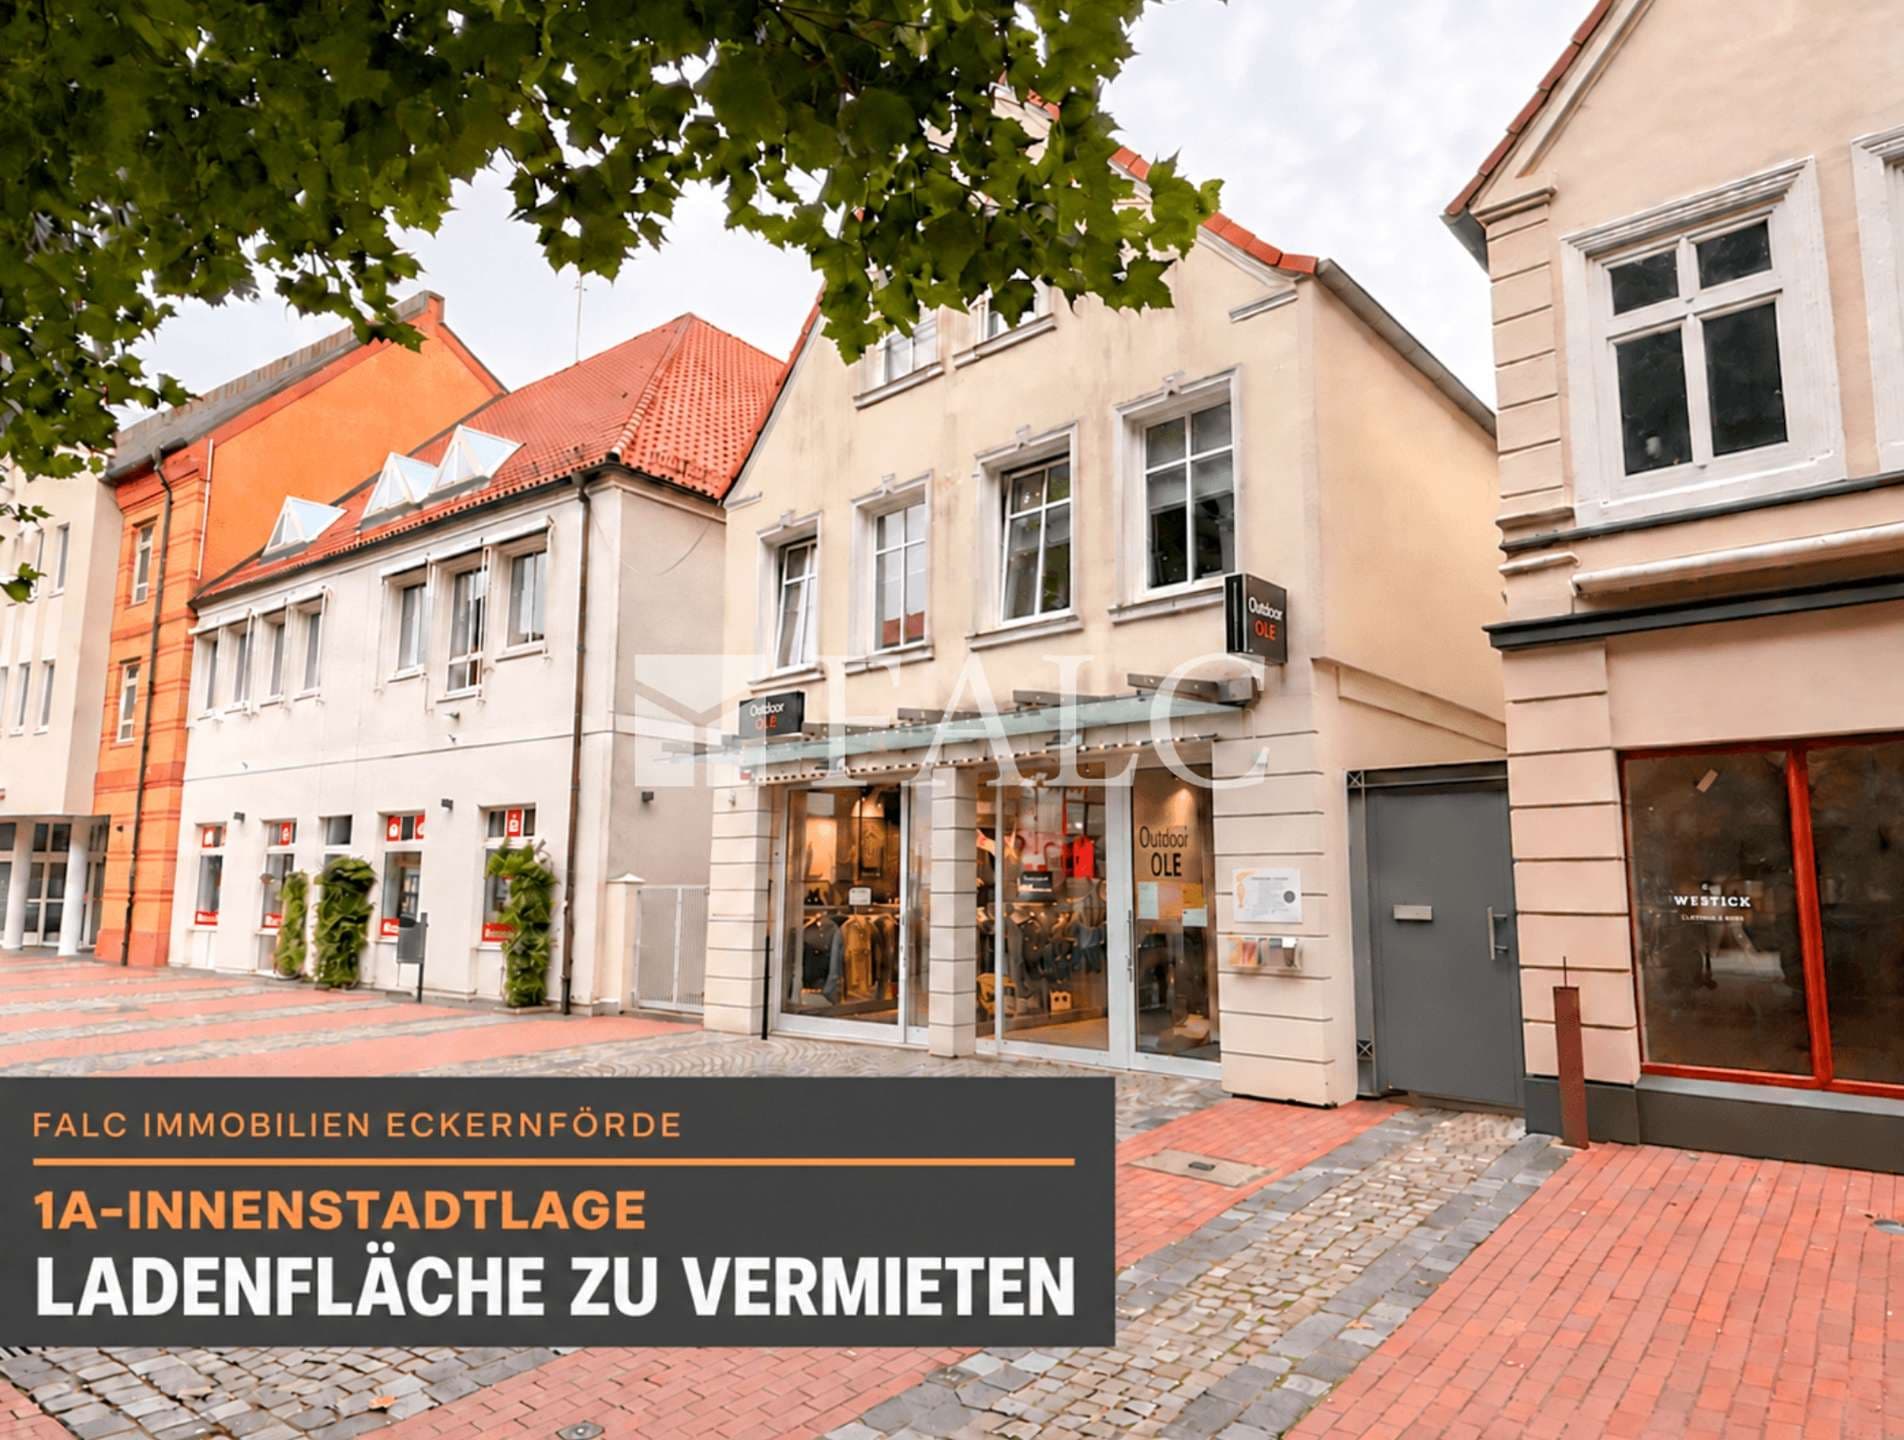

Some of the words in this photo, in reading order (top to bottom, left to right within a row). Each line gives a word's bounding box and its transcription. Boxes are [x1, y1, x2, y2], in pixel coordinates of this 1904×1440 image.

[1248, 597, 1283, 620] Outdoor
[1255, 620, 1277, 640] OLE
[750, 702, 785, 717] Outdoor
[755, 714, 777, 730] OLE
[1139, 826, 1189, 848] Outdoor
[1151, 853, 1183, 877] OLE
[1673, 896, 1751, 907] WESTICK
